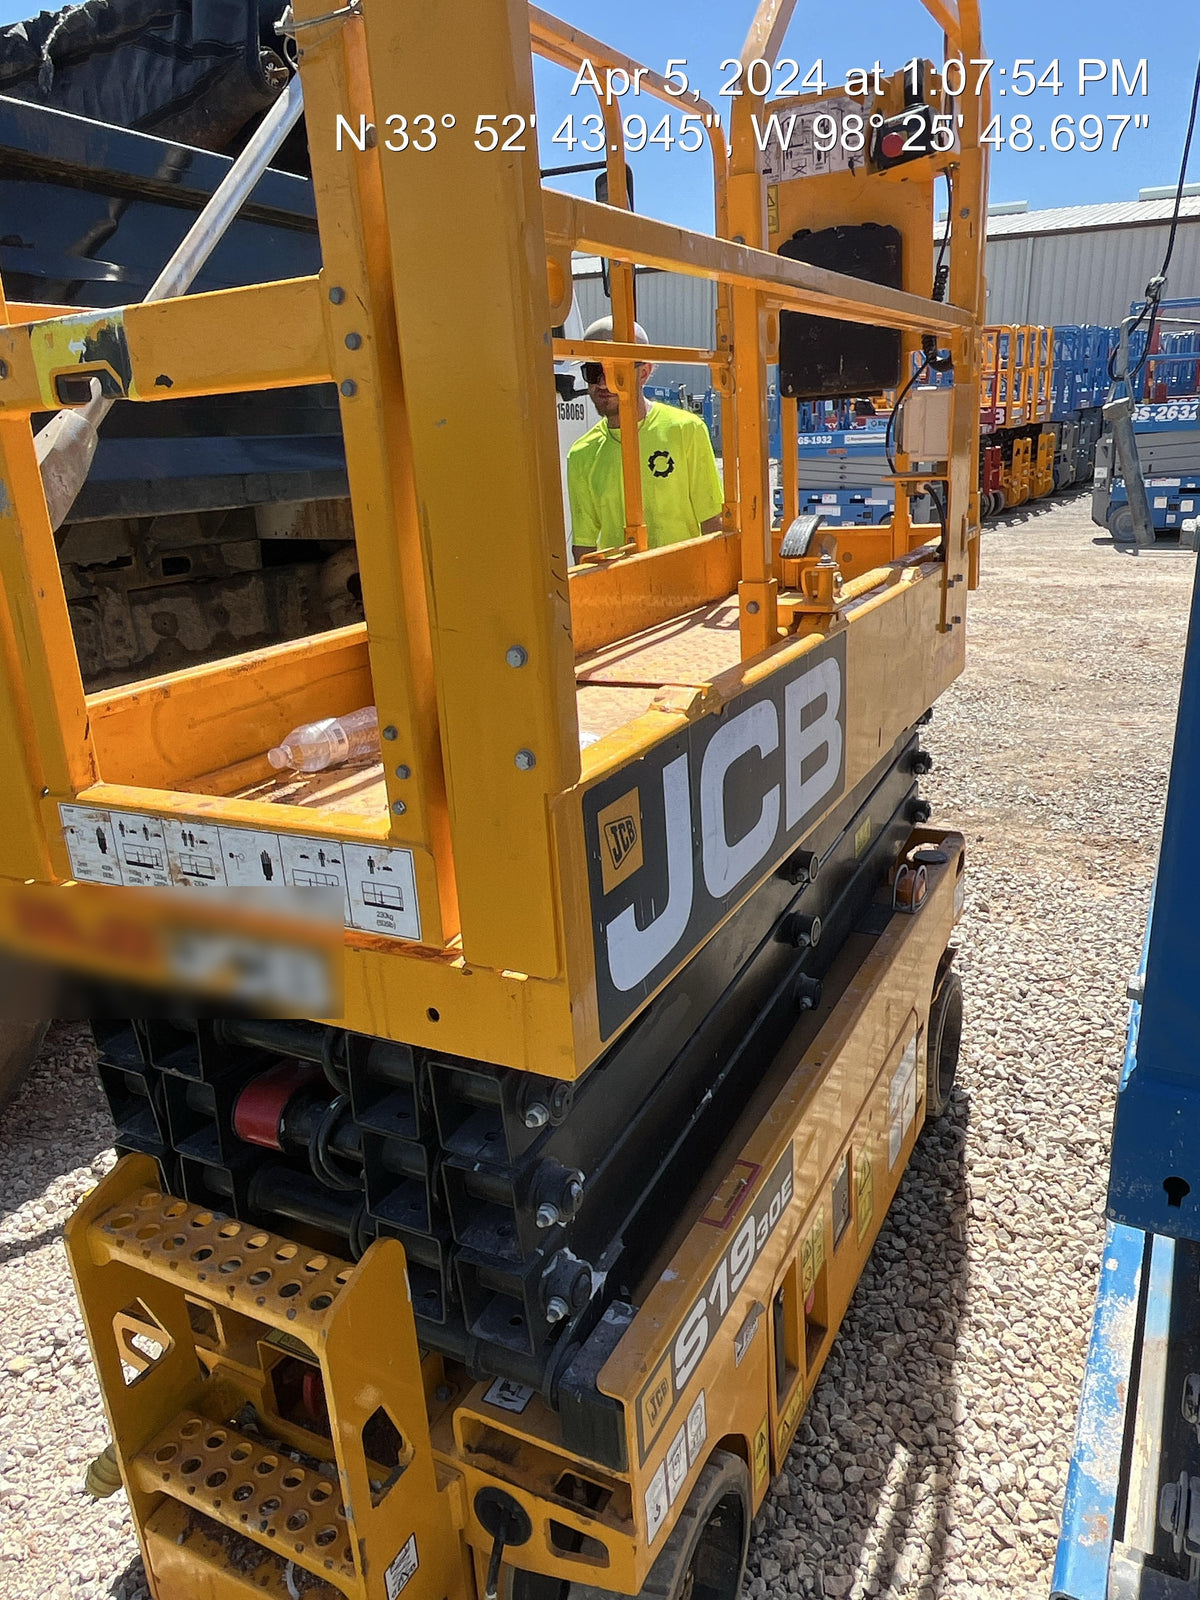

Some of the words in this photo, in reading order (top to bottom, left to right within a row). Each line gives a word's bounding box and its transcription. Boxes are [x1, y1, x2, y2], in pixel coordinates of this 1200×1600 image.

[557, 403, 585, 421] 158069
[797, 435, 832, 445] GS-1932
[607, 656, 842, 992] JCB
[610, 820, 635, 863] JCB
[649, 1380, 668, 1421] JCB
